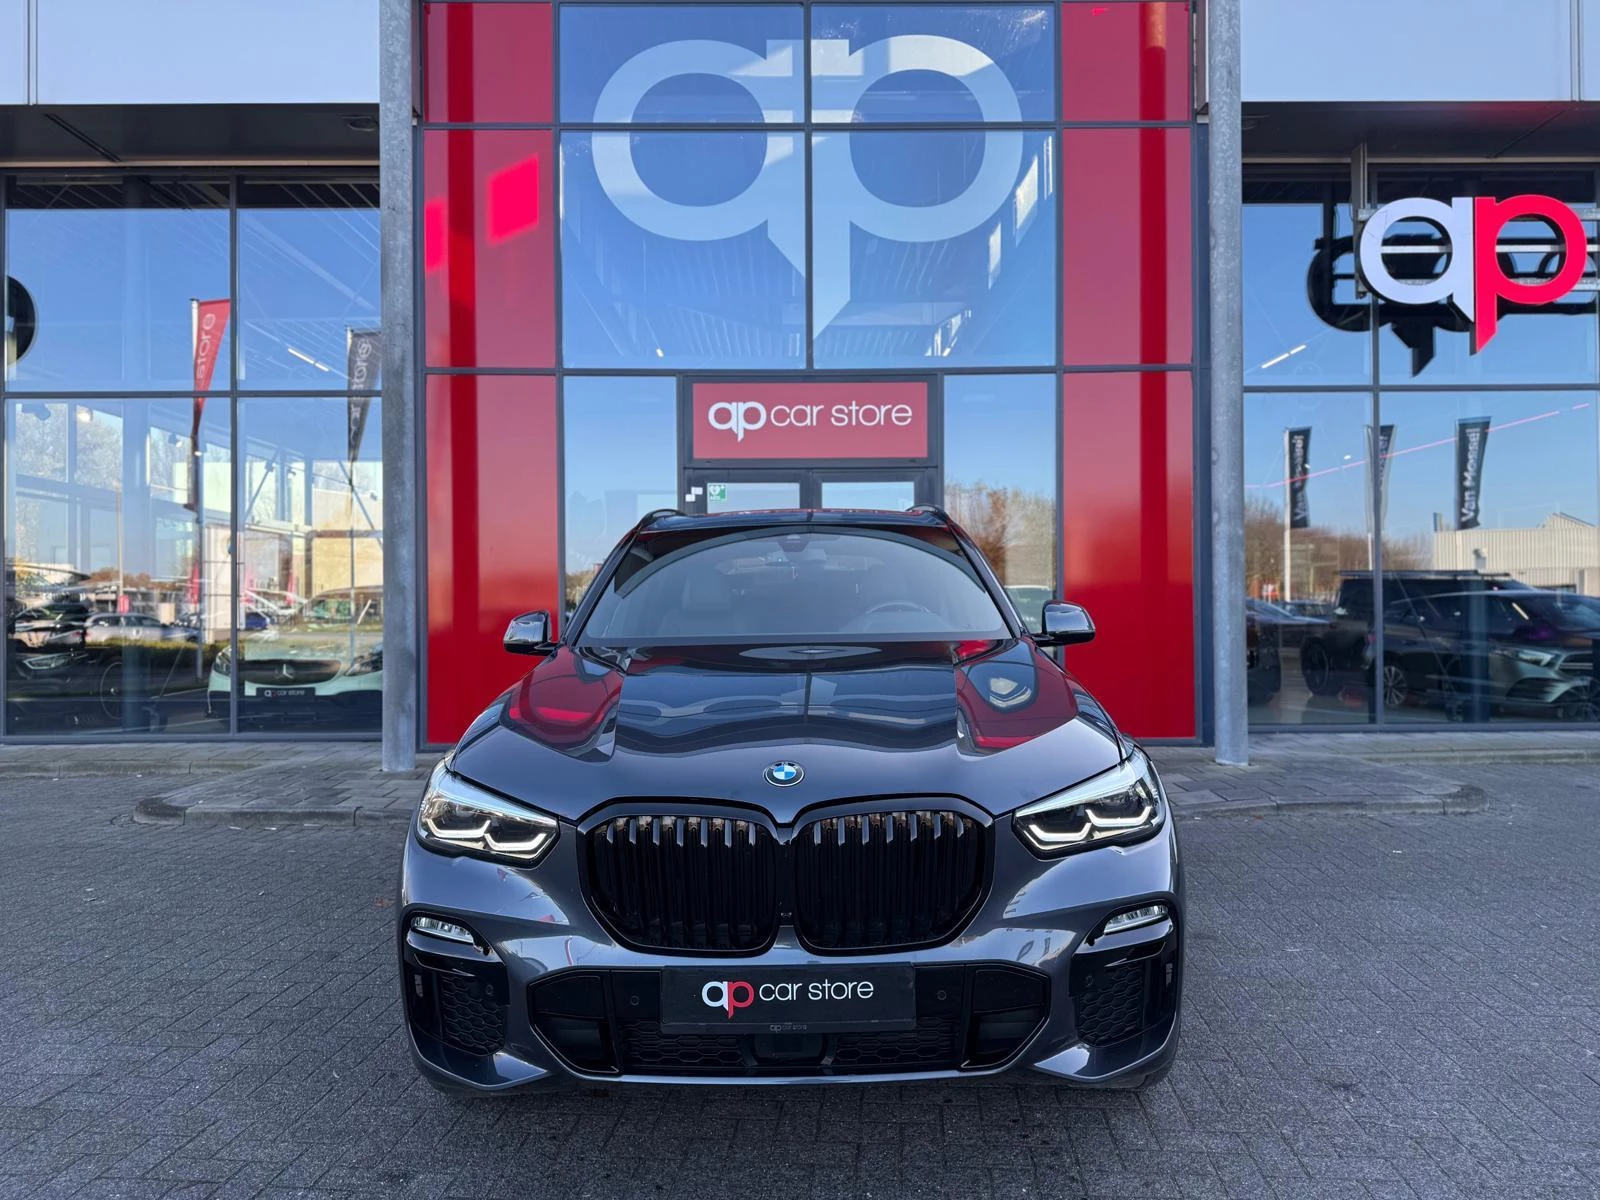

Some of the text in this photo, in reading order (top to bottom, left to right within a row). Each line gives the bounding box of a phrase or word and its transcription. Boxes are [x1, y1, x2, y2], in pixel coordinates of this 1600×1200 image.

[592, 35, 1023, 339] ap
[1360, 194, 1588, 354] ap
[708, 400, 912, 442] ap car store
[1460, 491, 1476, 523] Van
[701, 978, 874, 1019] ap car store
